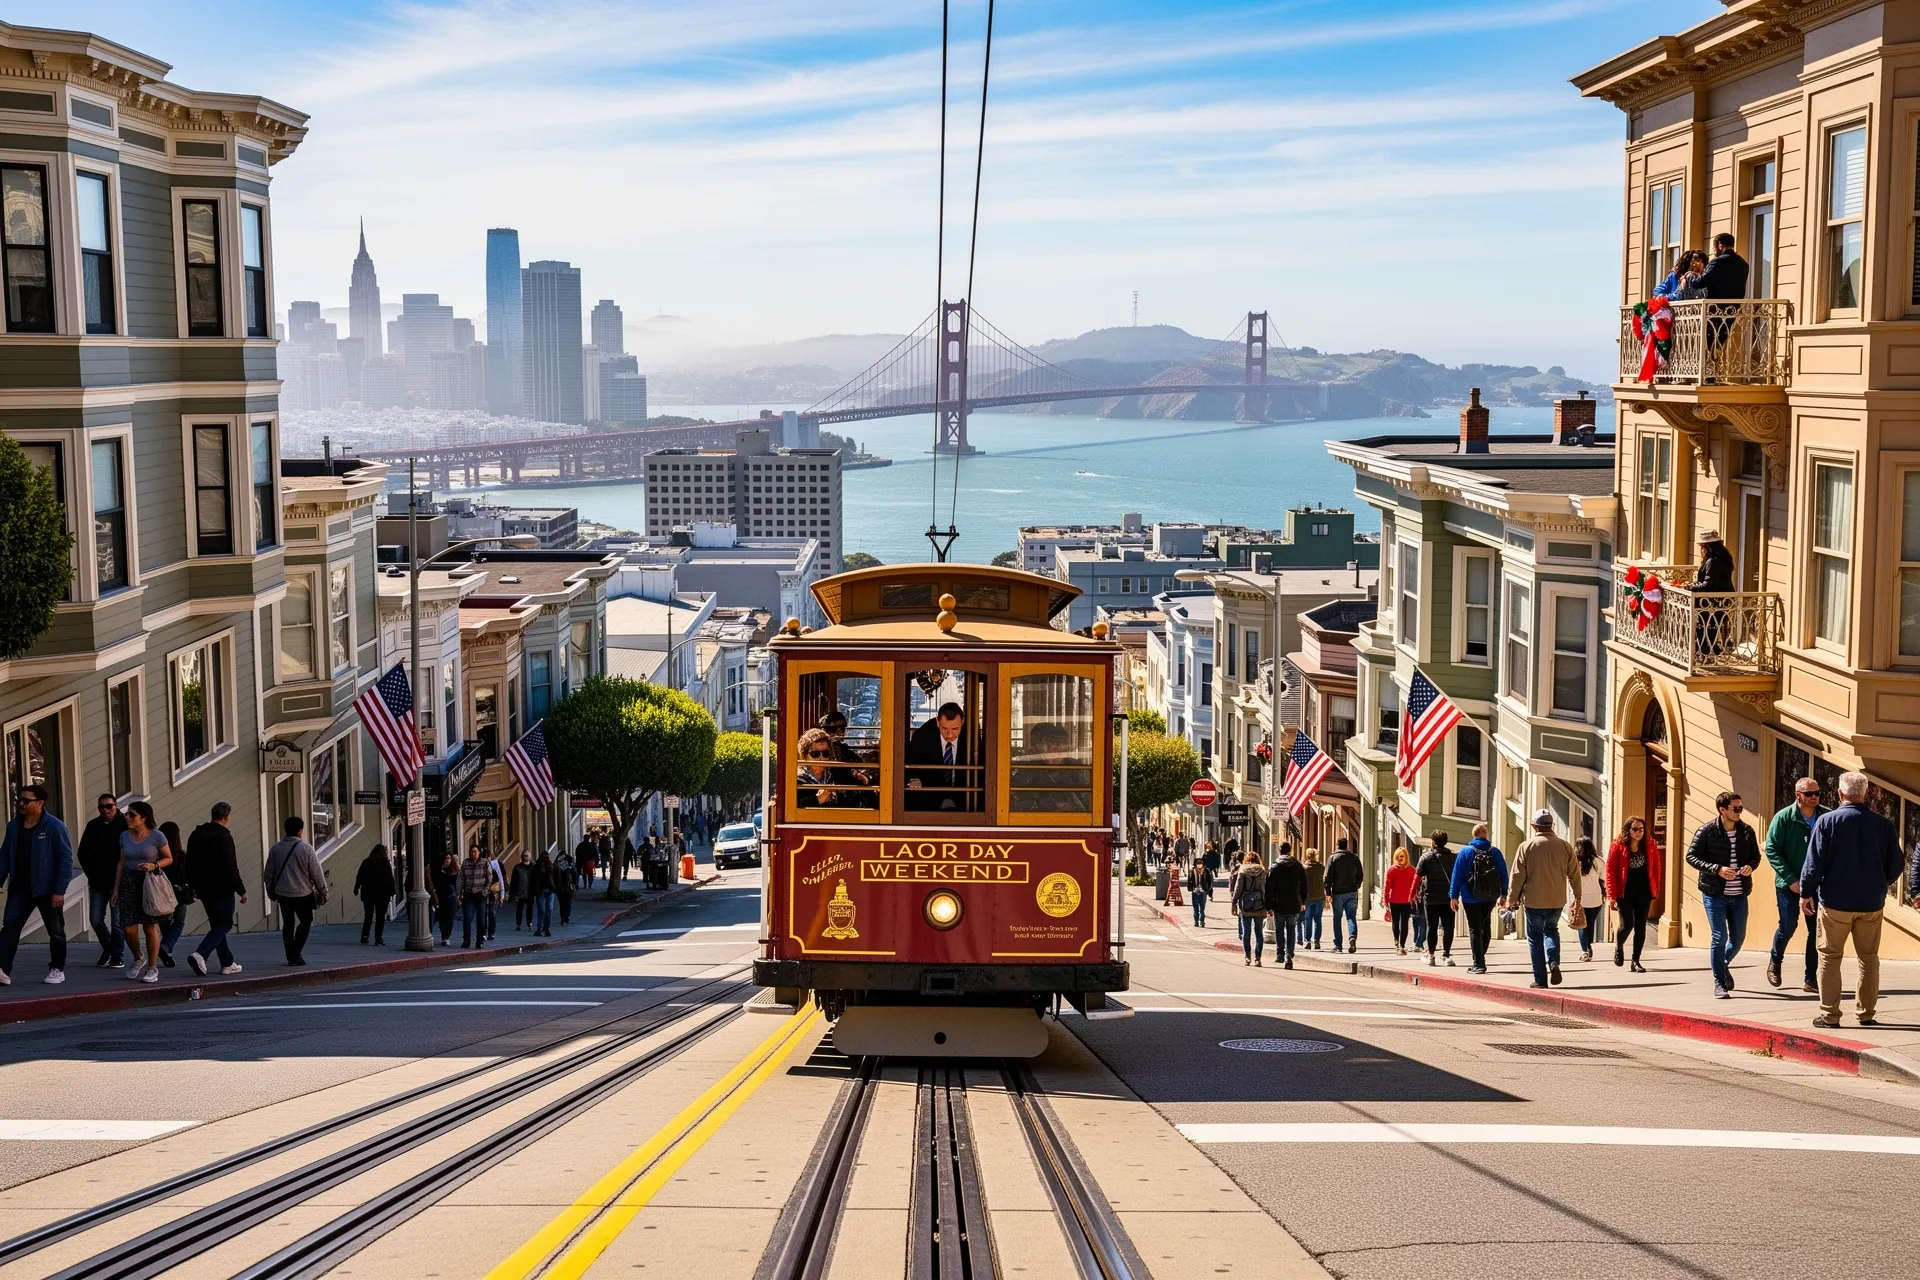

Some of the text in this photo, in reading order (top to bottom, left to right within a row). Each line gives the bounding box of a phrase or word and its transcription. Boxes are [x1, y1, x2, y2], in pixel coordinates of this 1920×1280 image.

[880, 843, 1014, 859] LAOR DAY
[869, 864, 1013, 880] WEEKEND
